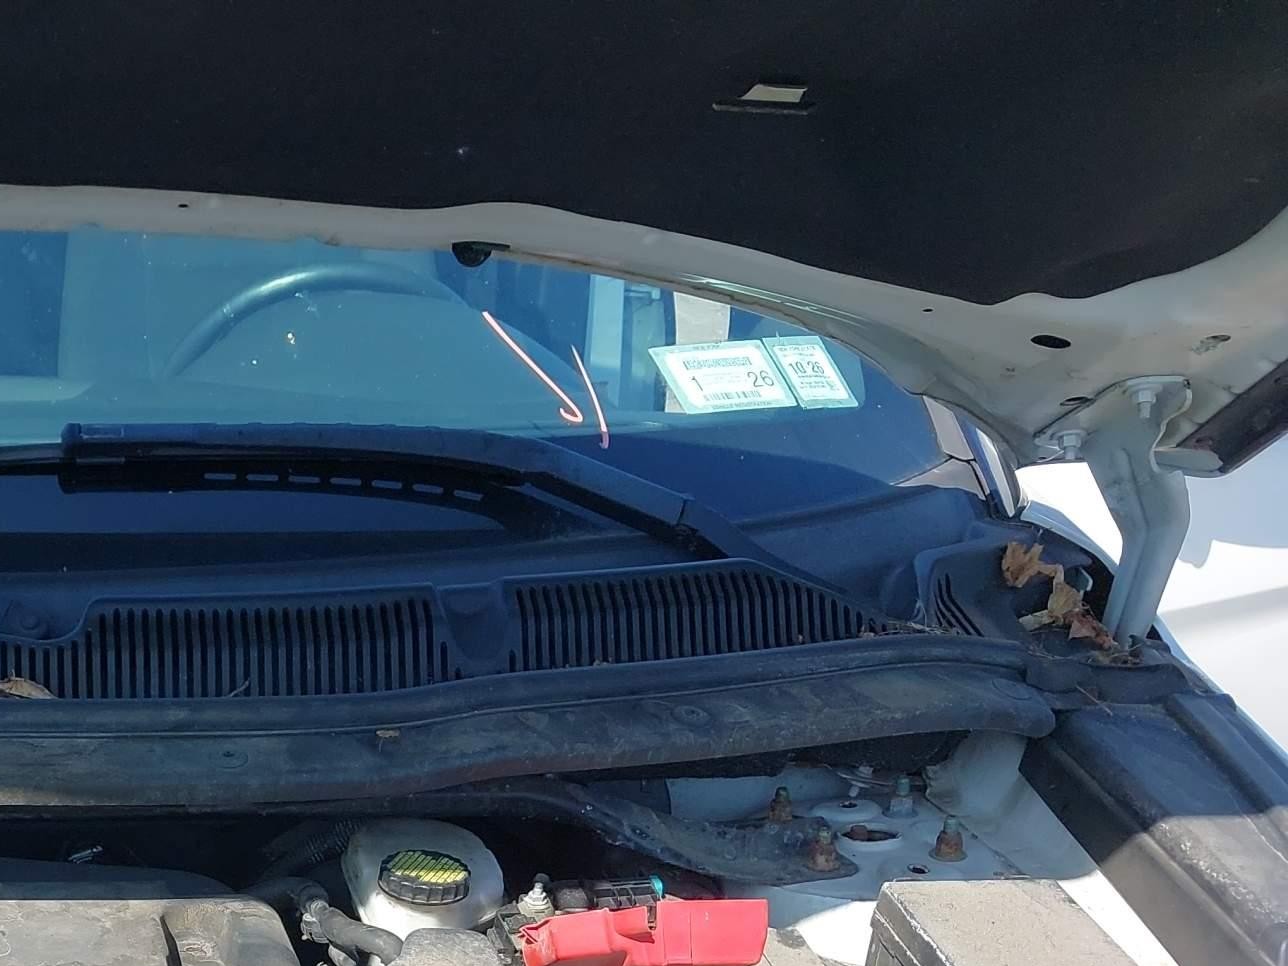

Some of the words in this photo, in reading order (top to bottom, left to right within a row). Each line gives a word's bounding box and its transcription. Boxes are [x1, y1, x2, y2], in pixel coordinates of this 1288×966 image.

[788, 361, 807, 375] 10
[690, 376, 703, 392] 1
[747, 369, 775, 388] 26
